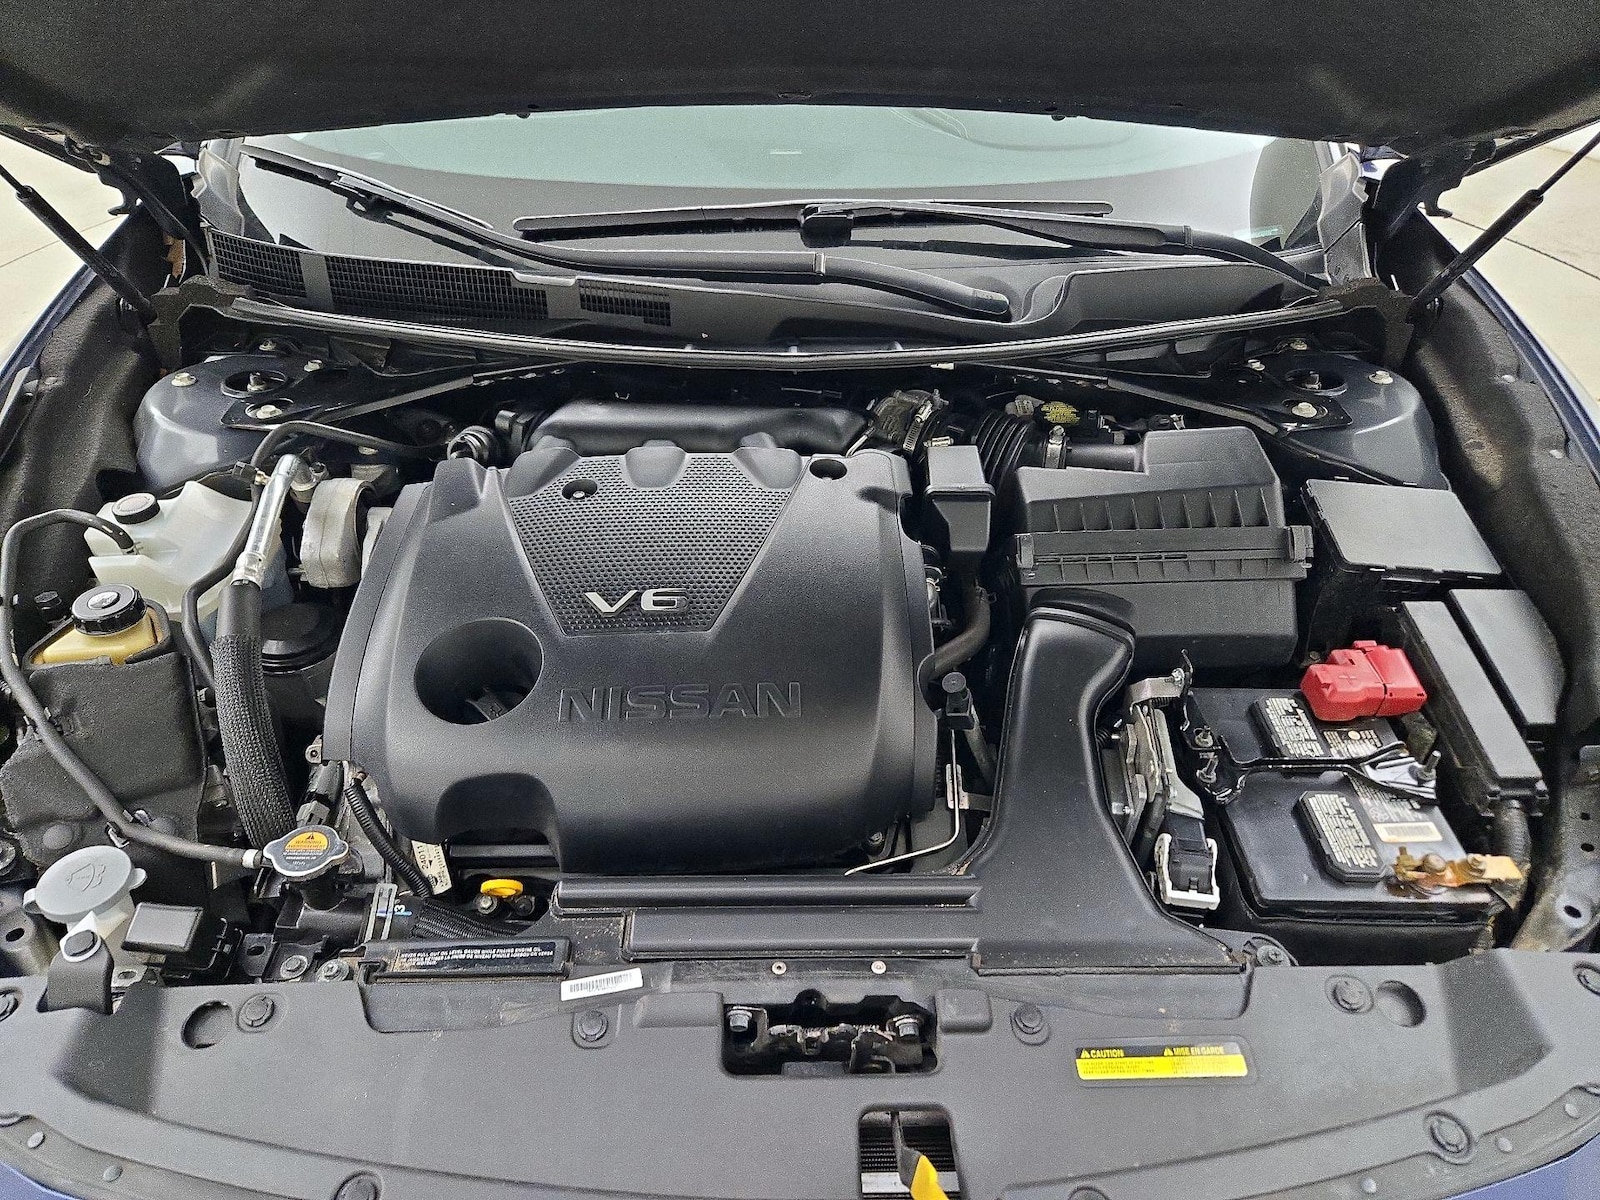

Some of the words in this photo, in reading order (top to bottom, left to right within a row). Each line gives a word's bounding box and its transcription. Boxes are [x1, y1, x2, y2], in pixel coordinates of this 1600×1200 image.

[584, 587, 689, 617] V6
[557, 682, 801, 722] NISSAN
[1090, 1049, 1124, 1058] CAUTION
[1190, 1046, 1200, 1055] EN
[1201, 1046, 1224, 1055] GARDE
